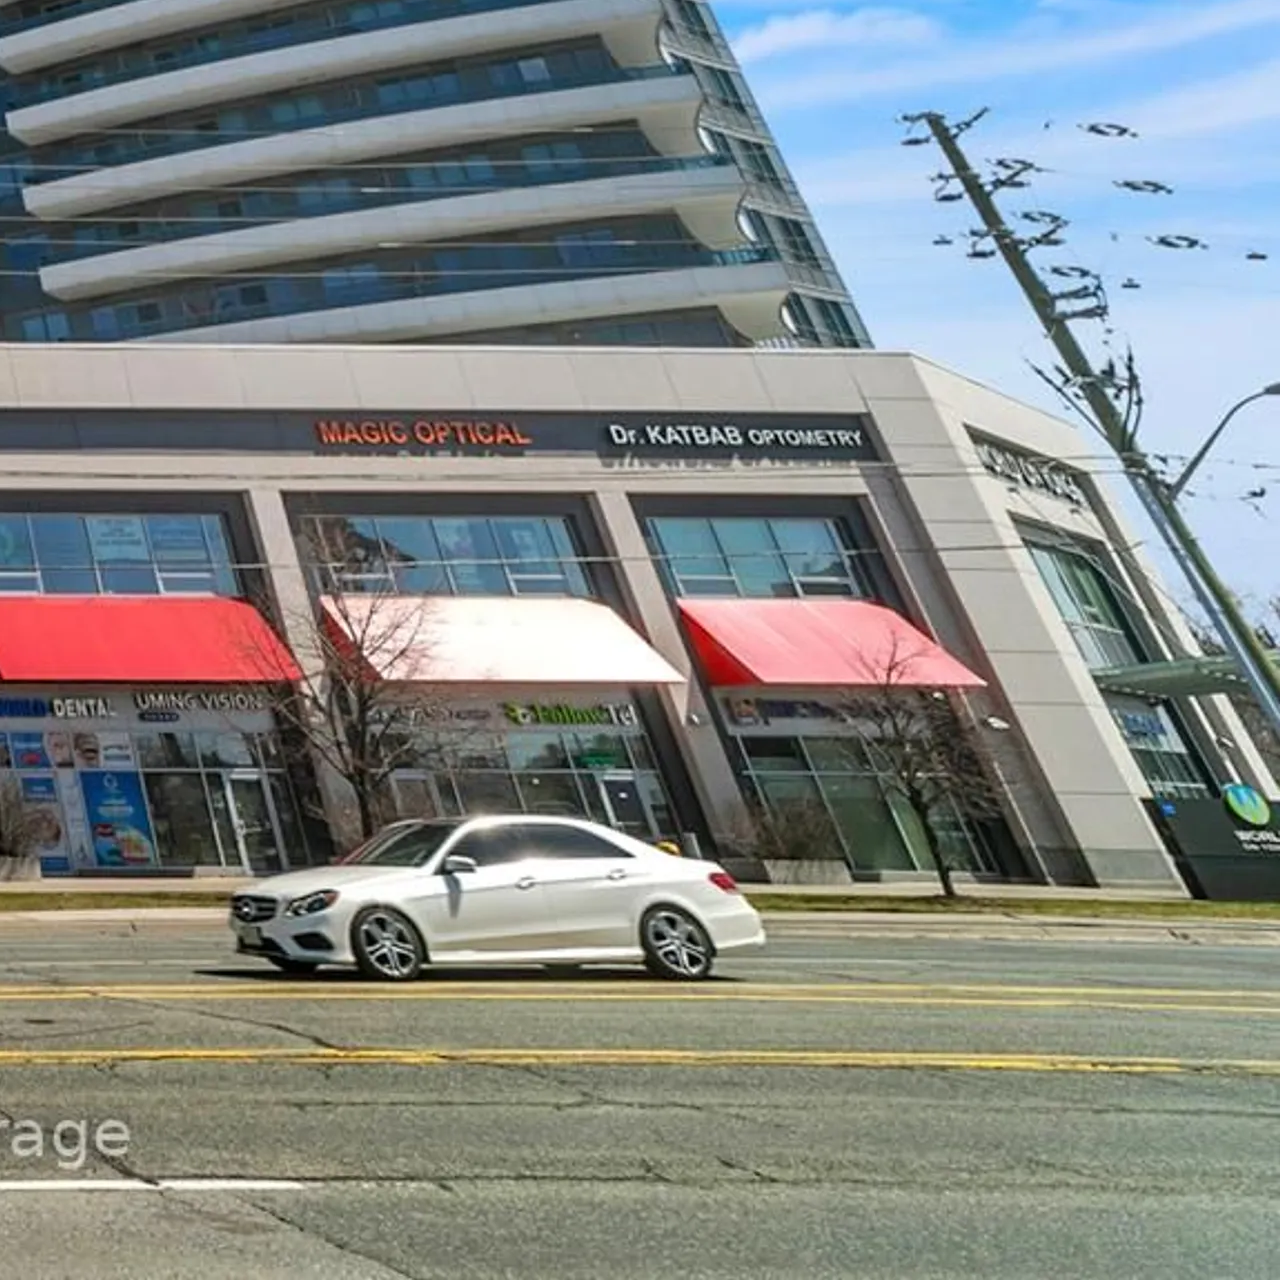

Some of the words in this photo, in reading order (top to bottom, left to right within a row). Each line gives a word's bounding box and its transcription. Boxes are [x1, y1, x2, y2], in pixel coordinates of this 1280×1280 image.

[318, 420, 408, 445] MAGIC
[413, 421, 533, 446] OPTICAL
[609, 425, 645, 445] Dr.
[646, 425, 743, 446] KATBAB
[747, 429, 863, 447] OPTOMETRY
[51, 698, 118, 718] DENTAL
[198, 693, 264, 710] VISION
